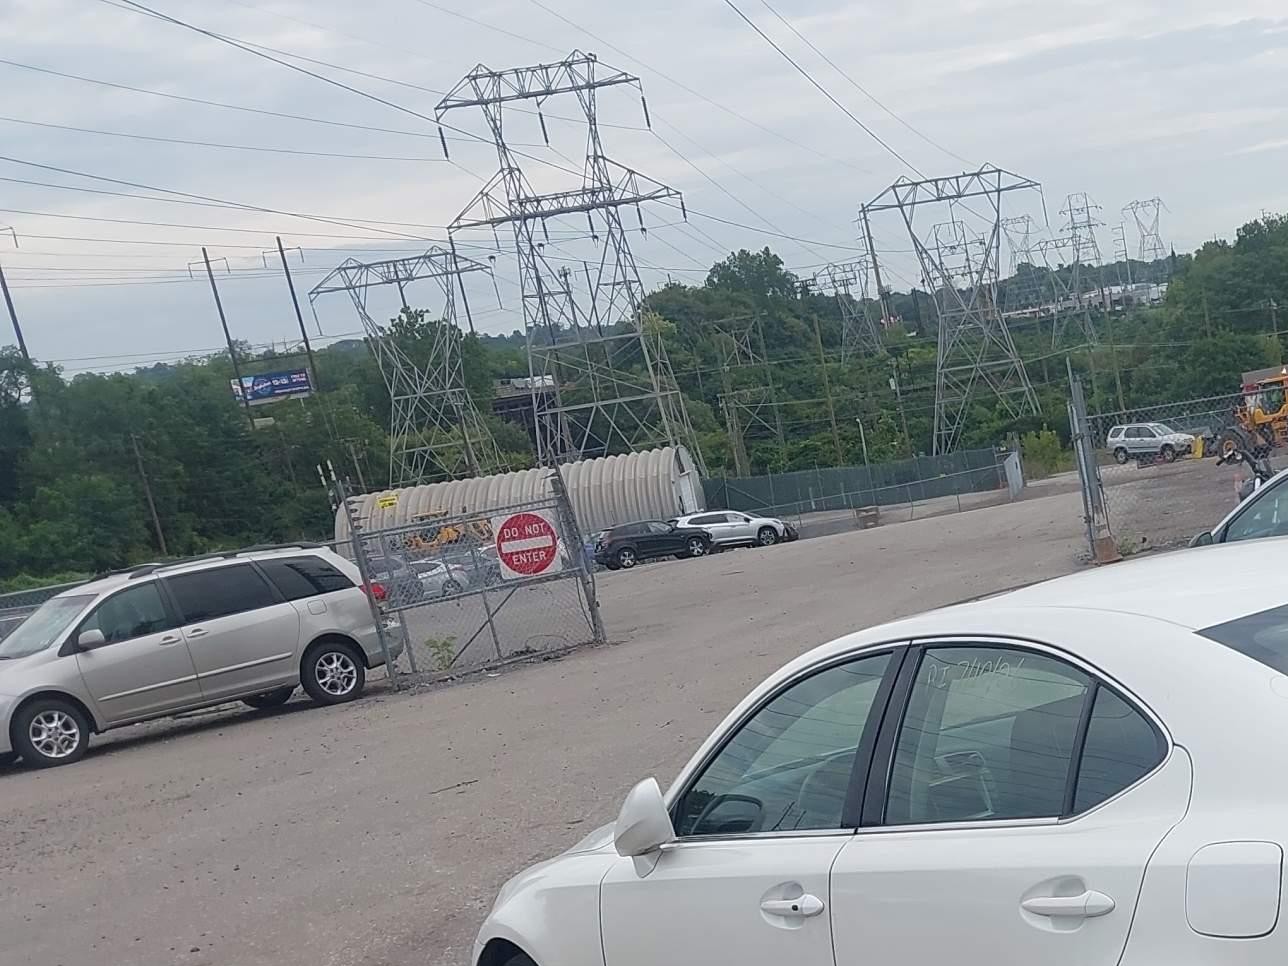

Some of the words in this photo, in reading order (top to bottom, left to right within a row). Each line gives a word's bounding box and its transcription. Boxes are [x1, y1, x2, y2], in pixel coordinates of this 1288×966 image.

[503, 527, 519, 539] DO
[524, 522, 546, 536] NOT
[512, 550, 547, 565] ENTER
